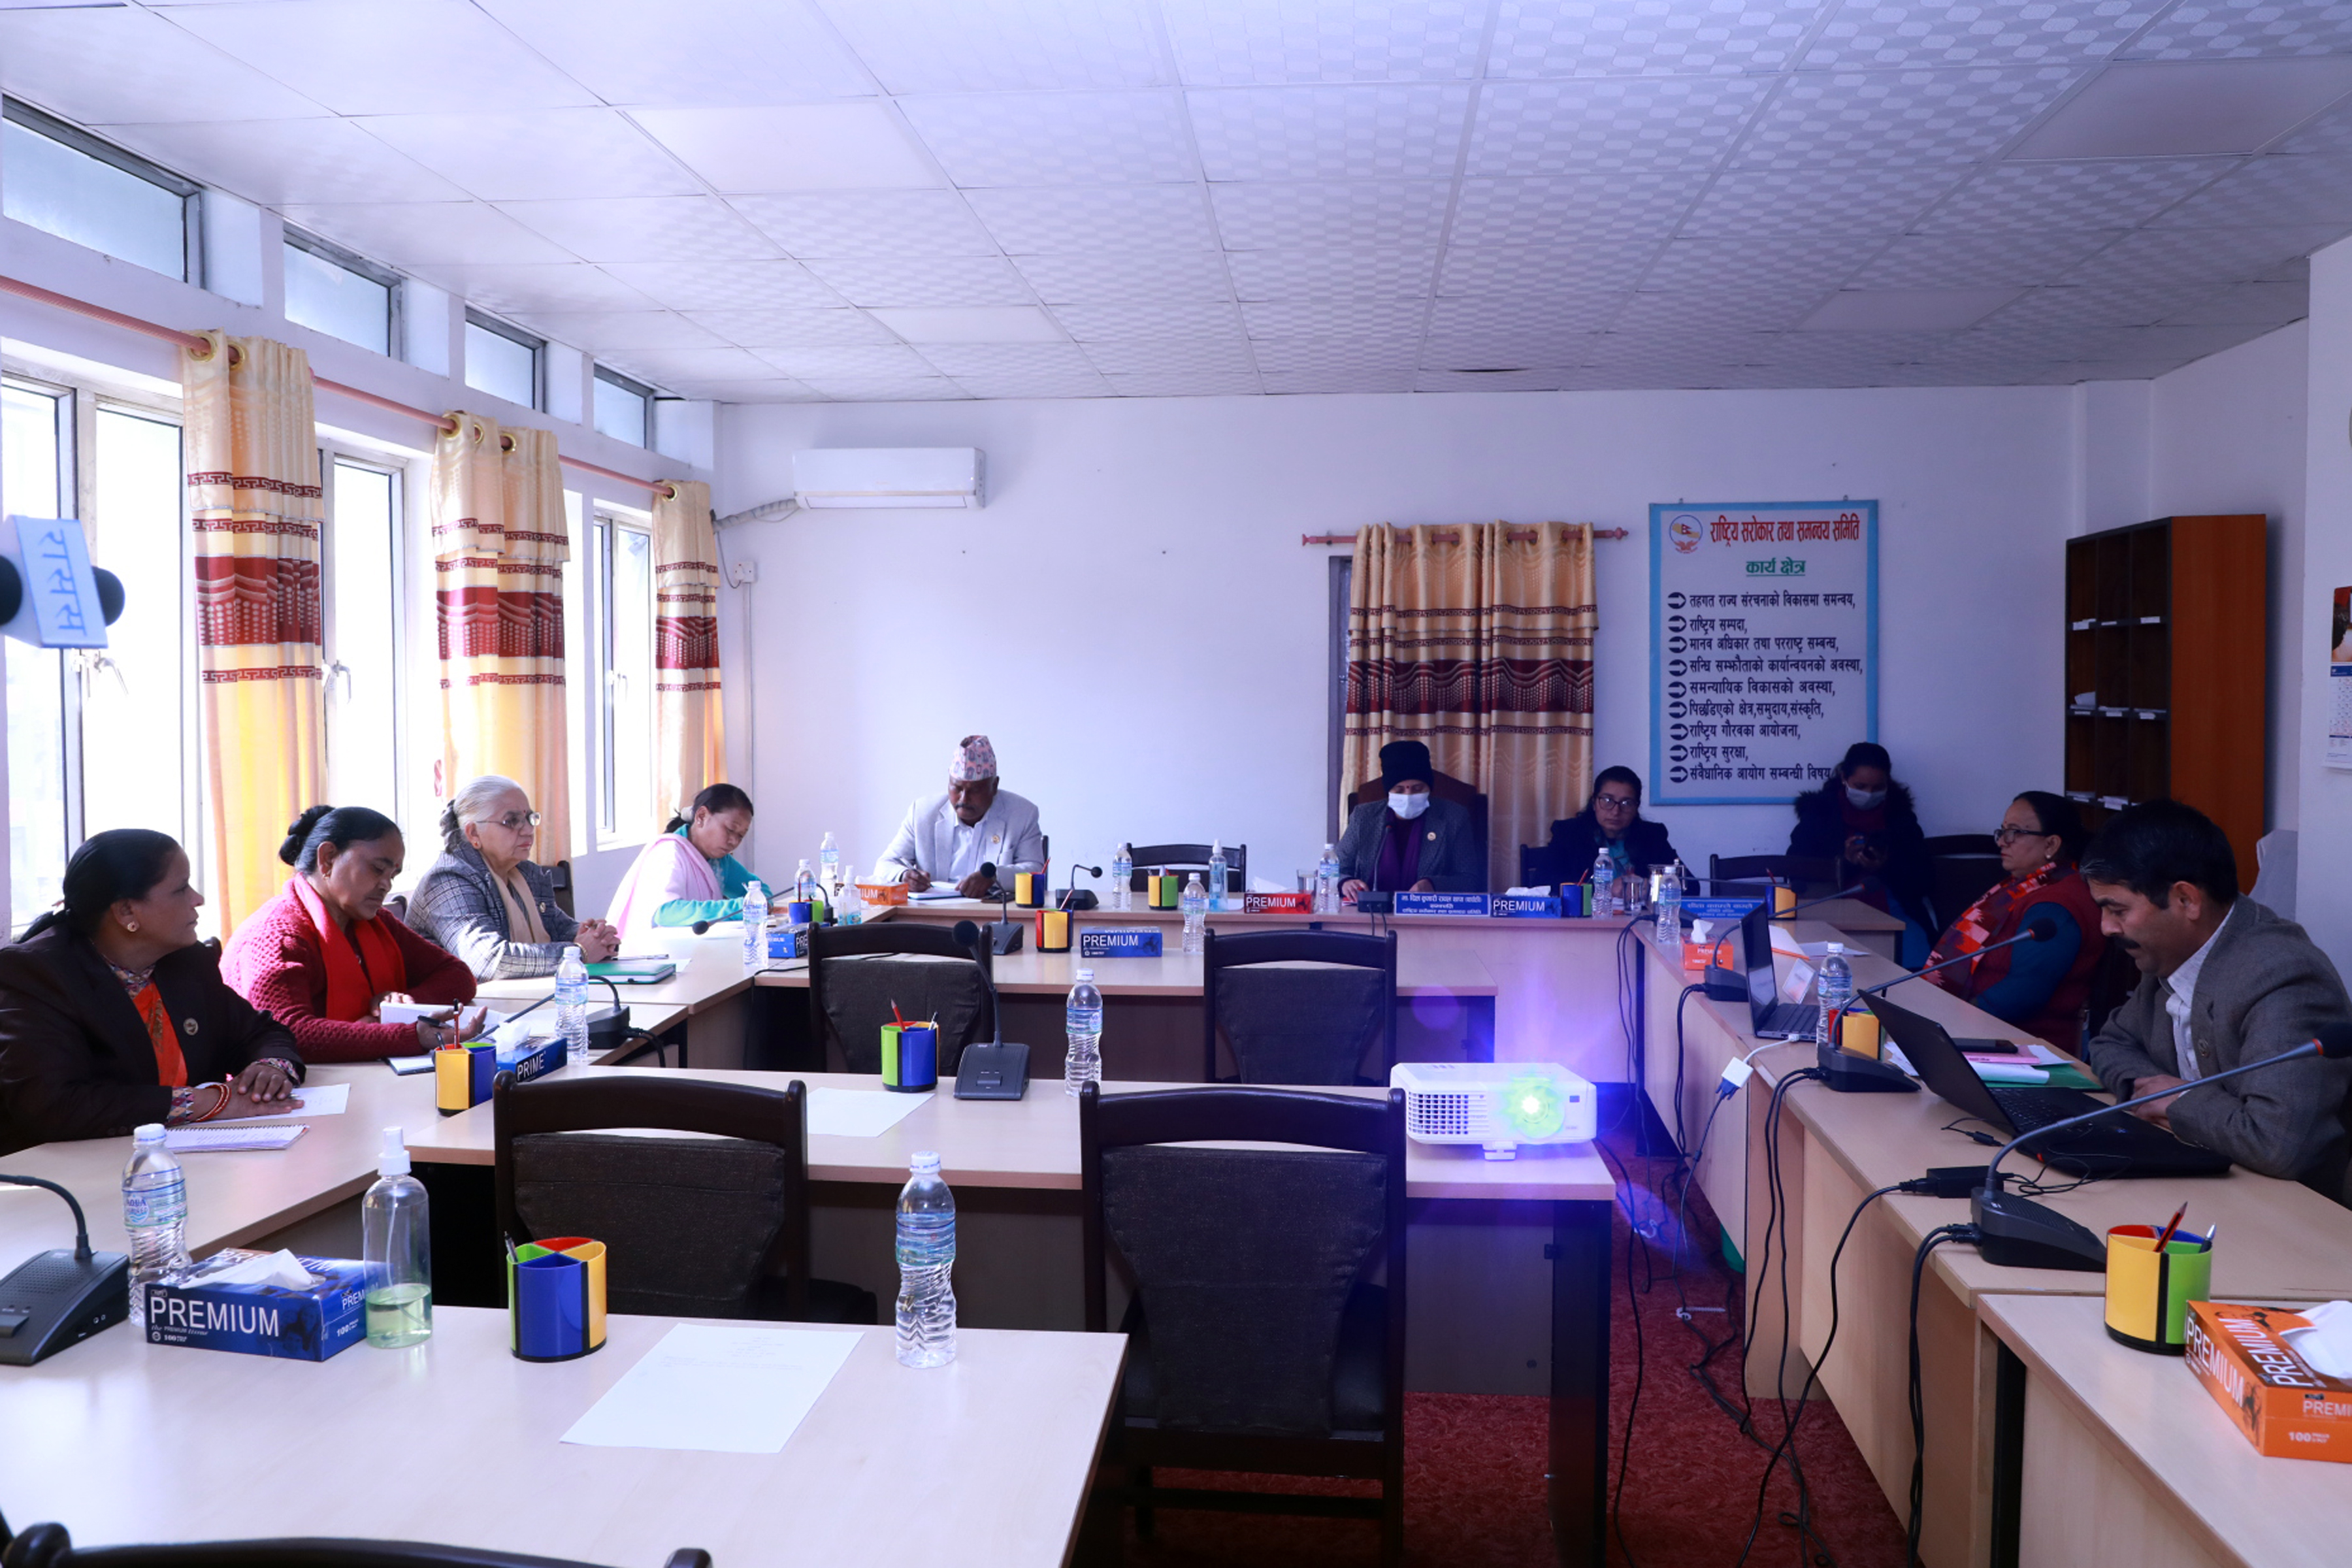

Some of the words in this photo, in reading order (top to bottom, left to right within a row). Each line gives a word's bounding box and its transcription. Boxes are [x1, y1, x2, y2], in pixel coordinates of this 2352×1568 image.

[1710, 515, 1739, 547] राष्ट्रिय
[1741, 515, 1775, 542] सरोकार
[1778, 521, 1795, 542] तथा
[1833, 513, 1859, 541] समिति
[1746, 557, 1776, 574] कार्य
[1780, 557, 1806, 574] क्षेत्र
[1690, 595, 1715, 608] तहगत
[1719, 595, 1737, 607] राज्य
[1741, 591, 1780, 607] संरचनाको
[1690, 615, 1715, 635] राष्ट्रिय
[1719, 619, 1748, 634] सम्पदा,
[1690, 638, 1713, 650] मानव
[1718, 634, 1749, 650] अधिकार
[1754, 638, 1771, 650] तथा
[1774, 637, 1803, 653] परराष्ट्र
[1807, 637, 1838, 652] सम्बन्ध,
[1690, 656, 1711, 673] सन्धि
[1768, 655, 1825, 672] कार्यान्वयनको
[1831, 659, 1863, 674] अवस्था,
[1690, 678, 1743, 694] समन्यायिक
[1748, 678, 1793, 694] विकासको
[1800, 681, 1835, 696] अवस्था,
[1690, 721, 1717, 740] राष्ट्रिय
[1722, 719, 1754, 737] गौरवका
[1759, 721, 1801, 740] आयोजना,
[1690, 742, 1718, 762] राष्ट्रिय
[1722, 747, 1748, 762] सुरक्षा,
[1690, 762, 1732, 780] संवैधानिक
[1737, 764, 1765, 780] आयोग
[1770, 763, 1803, 780] सम्बन्धी
[1246, 896, 1296, 907] PREMIUM
[1493, 900, 1545, 912] PREMIUM
[1083, 935, 1138, 946] PREMIUM
[517, 1053, 545, 1081] PRIME
[150, 1296, 279, 1337] PREMIUM
[2186, 1316, 2245, 1408] PREMIUM
[2217, 1318, 2314, 1387] PREMIUM
[2289, 1432, 2311, 1443] 100
